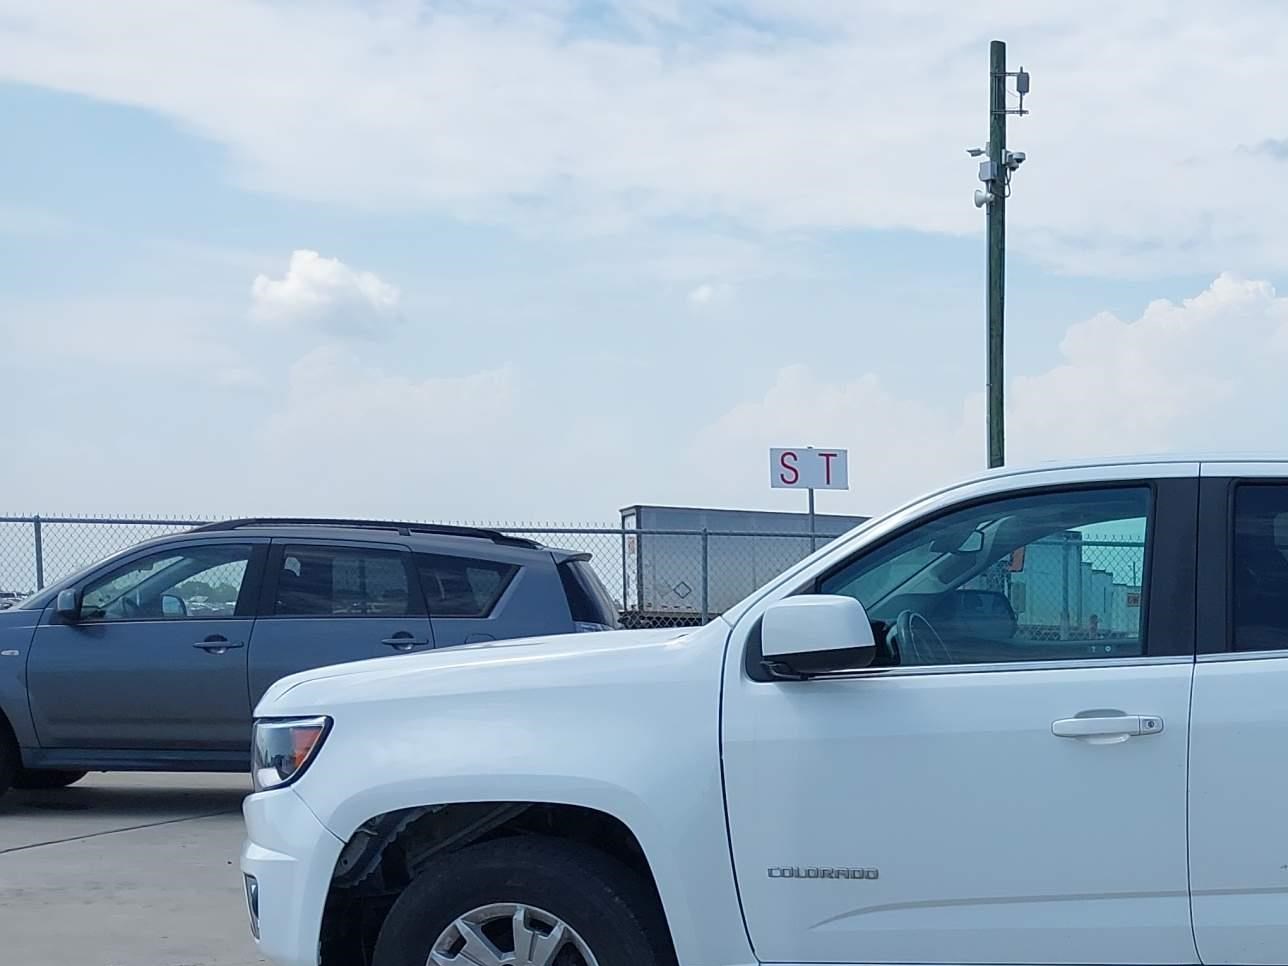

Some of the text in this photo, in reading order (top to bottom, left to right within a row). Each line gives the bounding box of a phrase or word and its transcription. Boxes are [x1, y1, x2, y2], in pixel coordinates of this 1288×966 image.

[780, 451, 837, 485] S T
[767, 866, 880, 880] COLORADO
